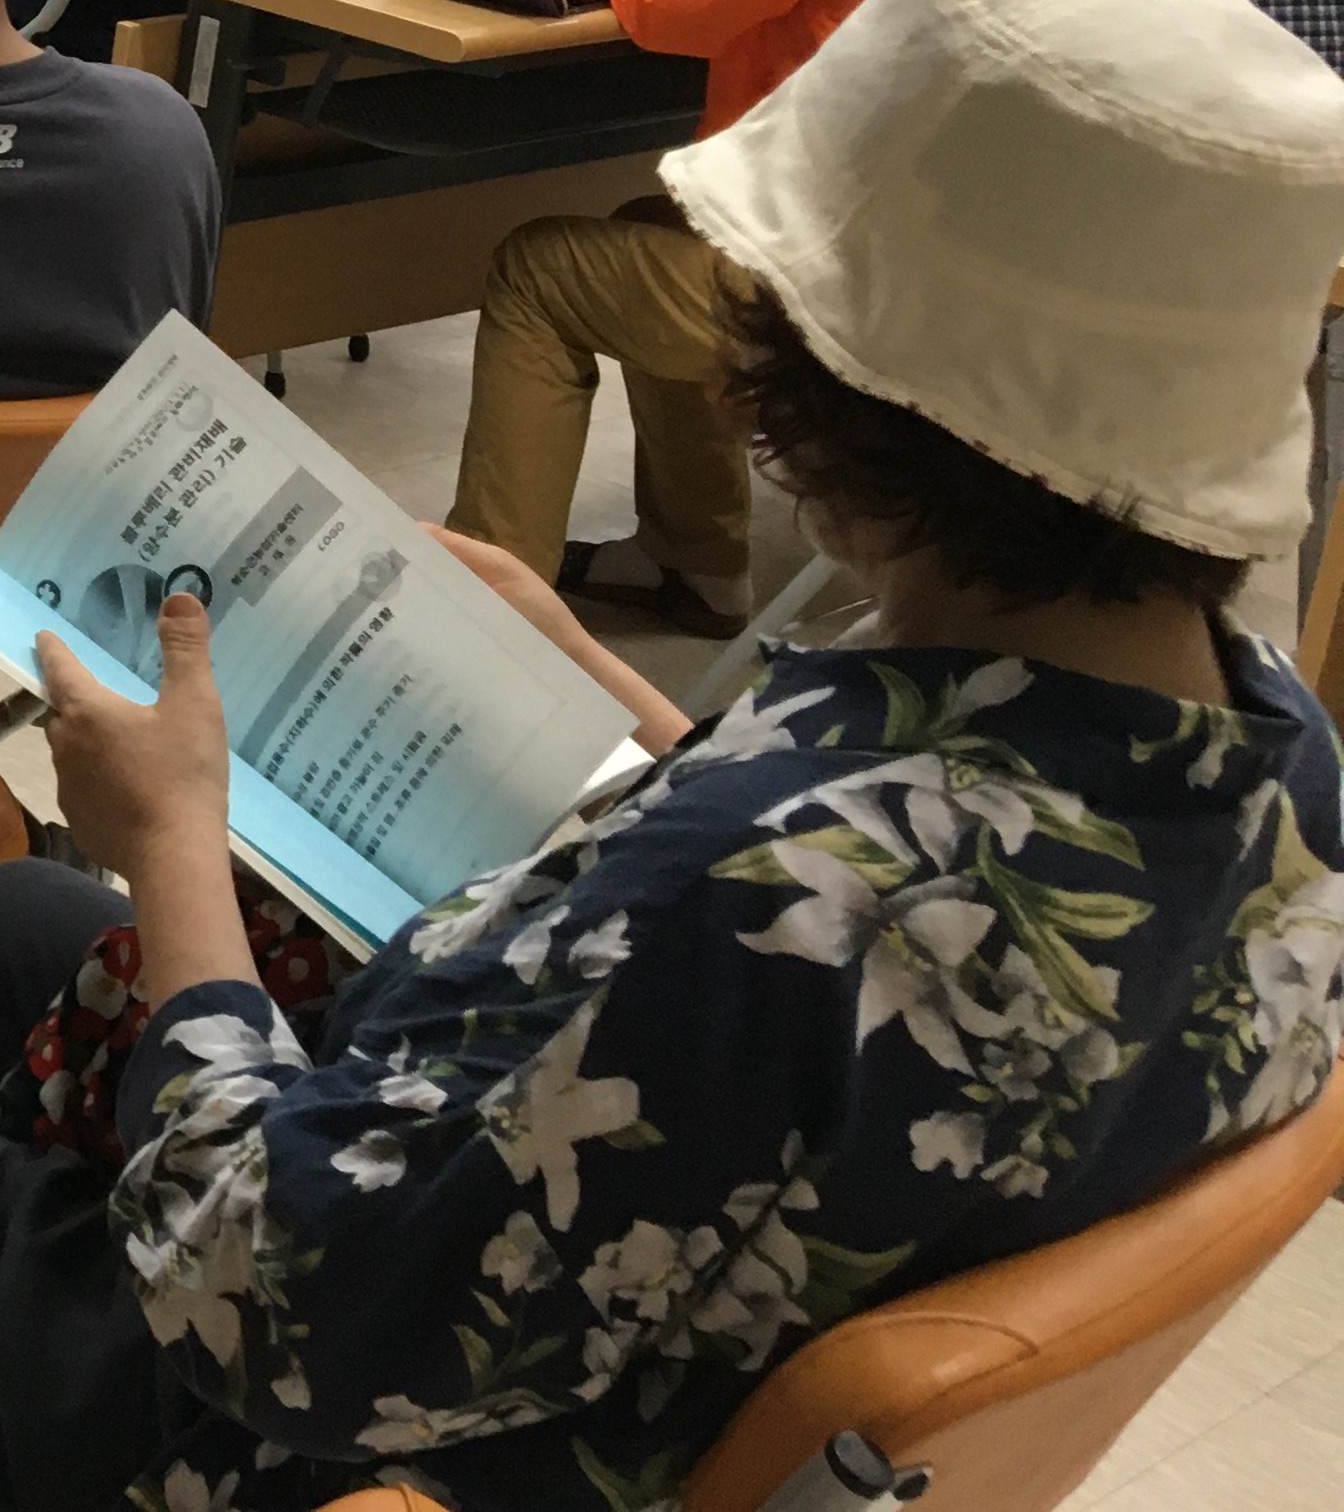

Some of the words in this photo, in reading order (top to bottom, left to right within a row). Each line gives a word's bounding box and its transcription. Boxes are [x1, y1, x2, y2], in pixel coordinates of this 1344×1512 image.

[120, 480, 174, 546] 블루베리
[167, 418, 229, 482] 관비재배
[178, 468, 217, 510] 관리)
[214, 435, 247, 469] 기술
